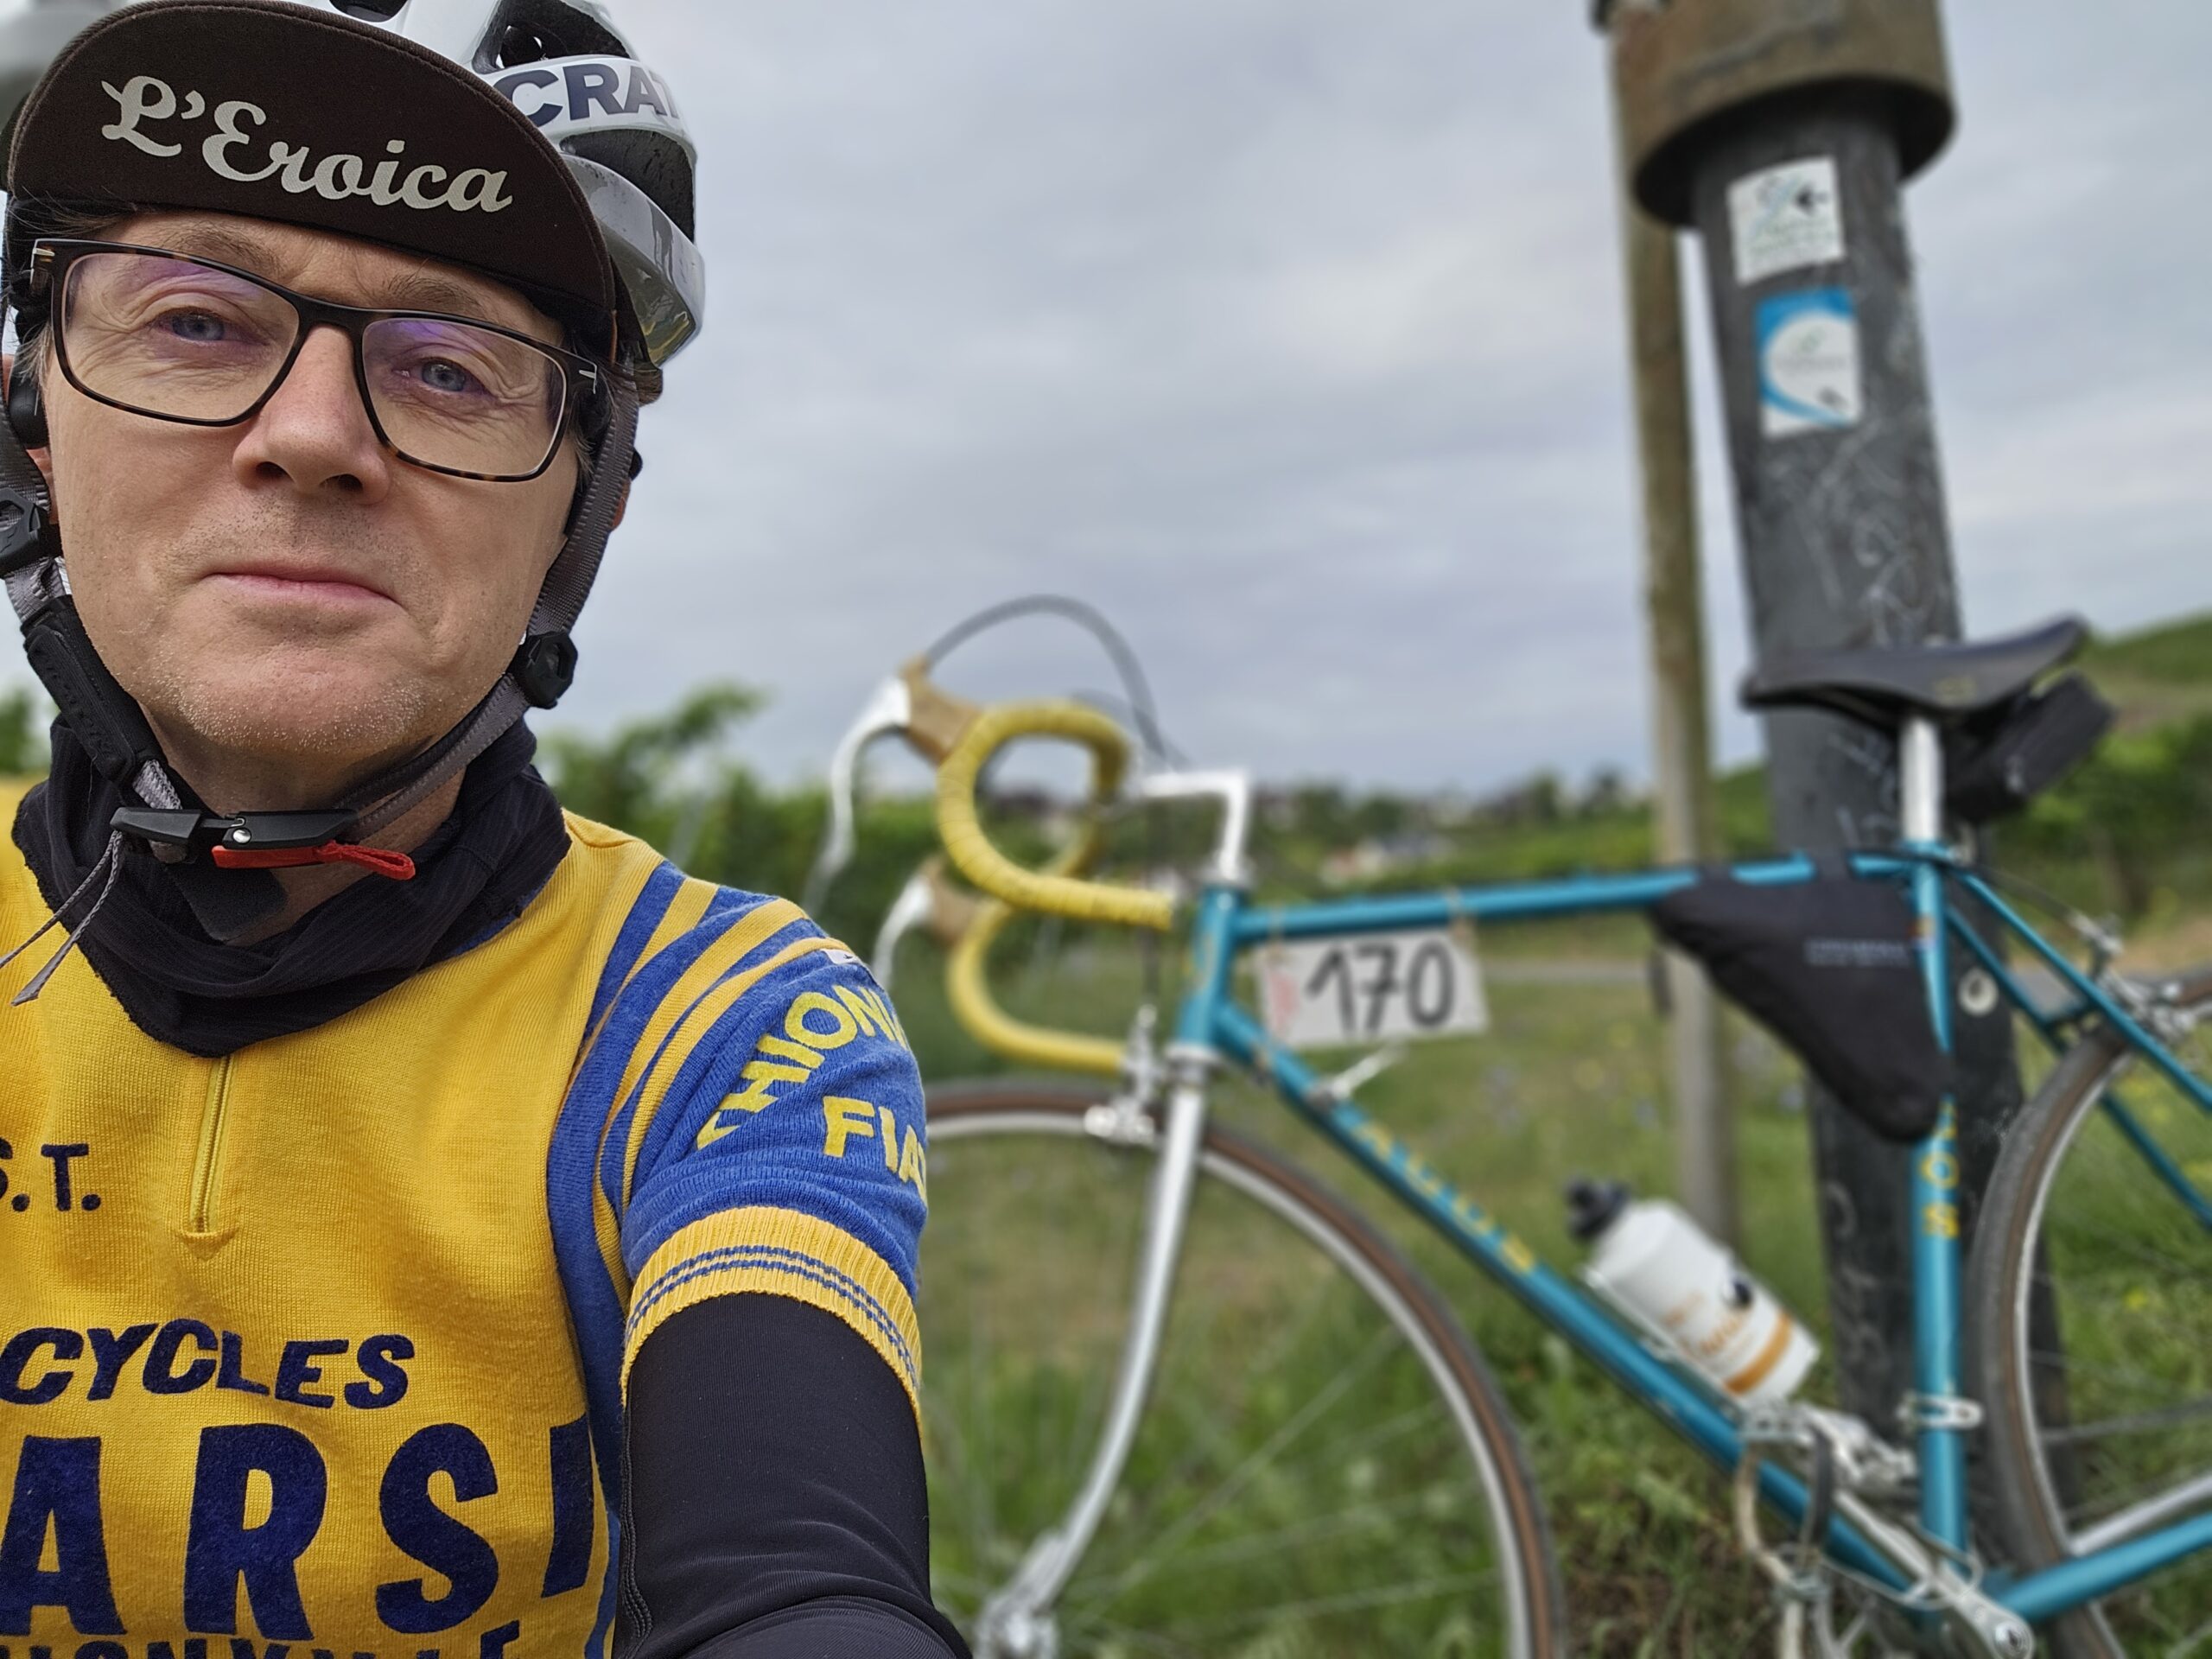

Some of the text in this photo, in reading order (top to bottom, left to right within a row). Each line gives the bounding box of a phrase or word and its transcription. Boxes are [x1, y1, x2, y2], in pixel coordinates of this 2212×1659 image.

[101, 75, 513, 213] L'Eroica
[1304, 938, 1455, 1039] 170
[823, 1096, 926, 1206] FIA
[0, 1319, 415, 1408] CYCLES
